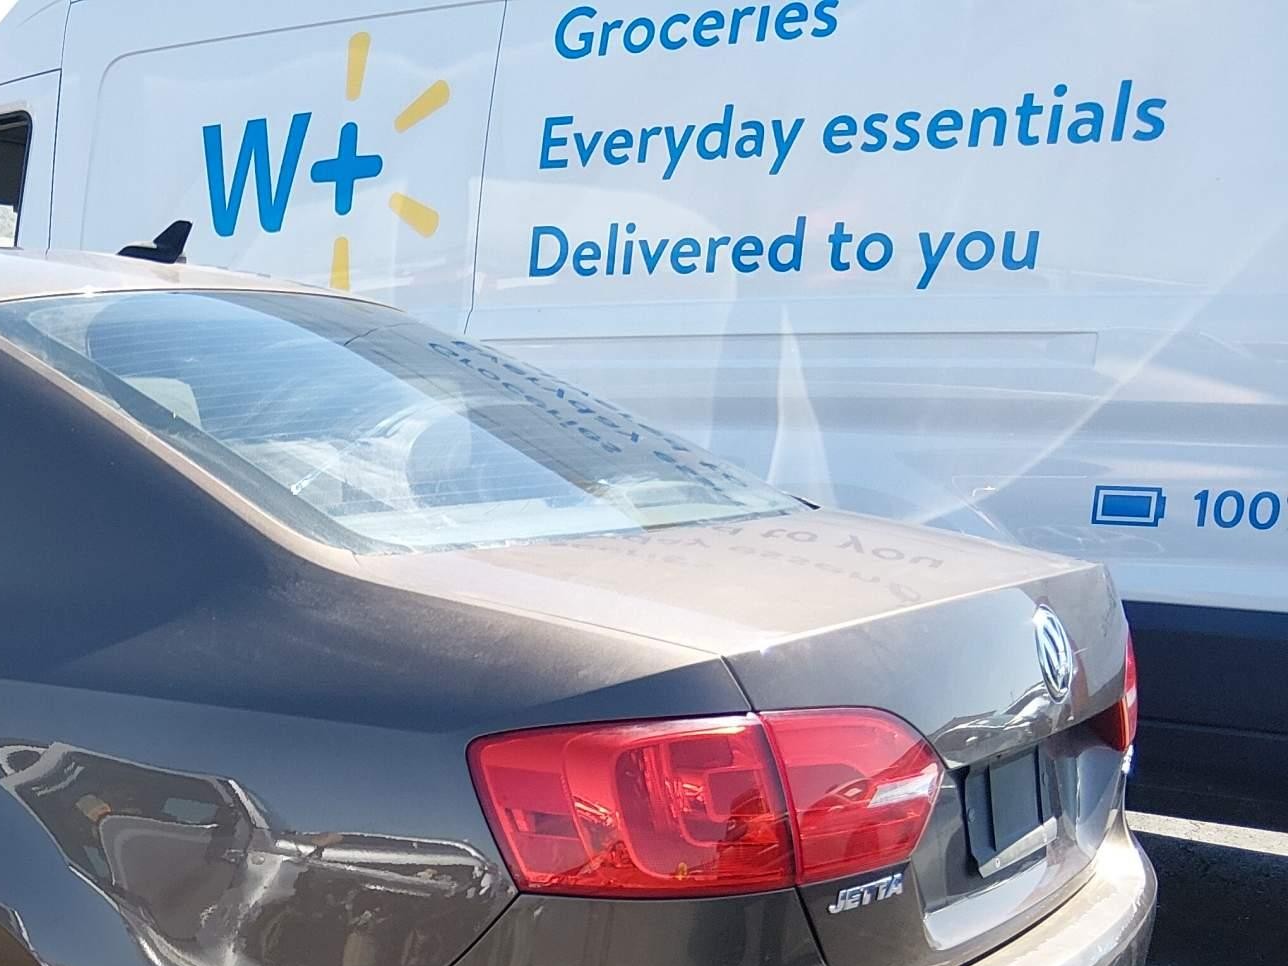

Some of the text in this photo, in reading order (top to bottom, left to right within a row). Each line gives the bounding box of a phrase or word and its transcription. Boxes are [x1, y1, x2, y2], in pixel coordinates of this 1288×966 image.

[555, 0, 839, 59] Groceries
[539, 80, 1167, 180] Everyday essentials
[203, 112, 383, 237] W+
[529, 216, 1040, 290] Delivered to you
[1194, 489, 1288, 530] 100
[828, 873, 904, 914] JETTA
